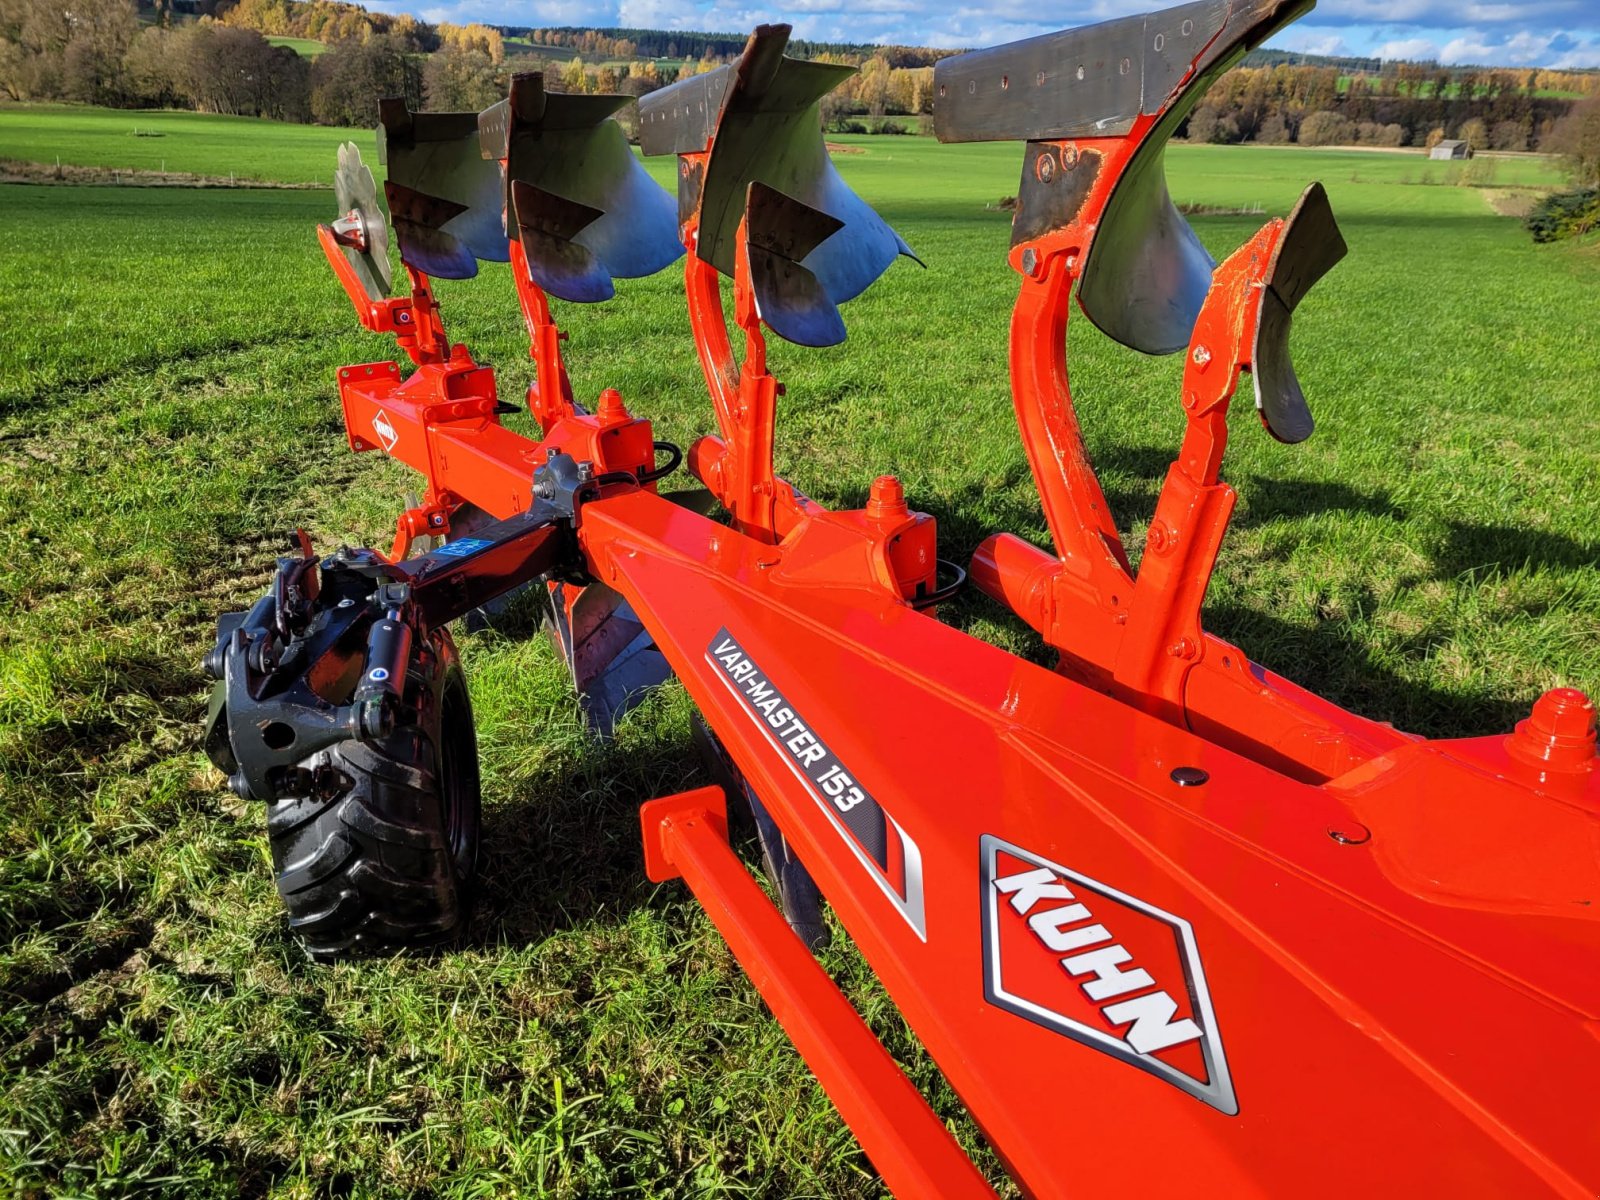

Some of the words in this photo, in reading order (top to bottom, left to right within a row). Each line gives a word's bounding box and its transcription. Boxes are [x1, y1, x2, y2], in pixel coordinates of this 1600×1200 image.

[713, 638, 827, 769] VARI-MASTER
[816, 765, 865, 812] 153
[992, 867, 1204, 1055] KUHN
